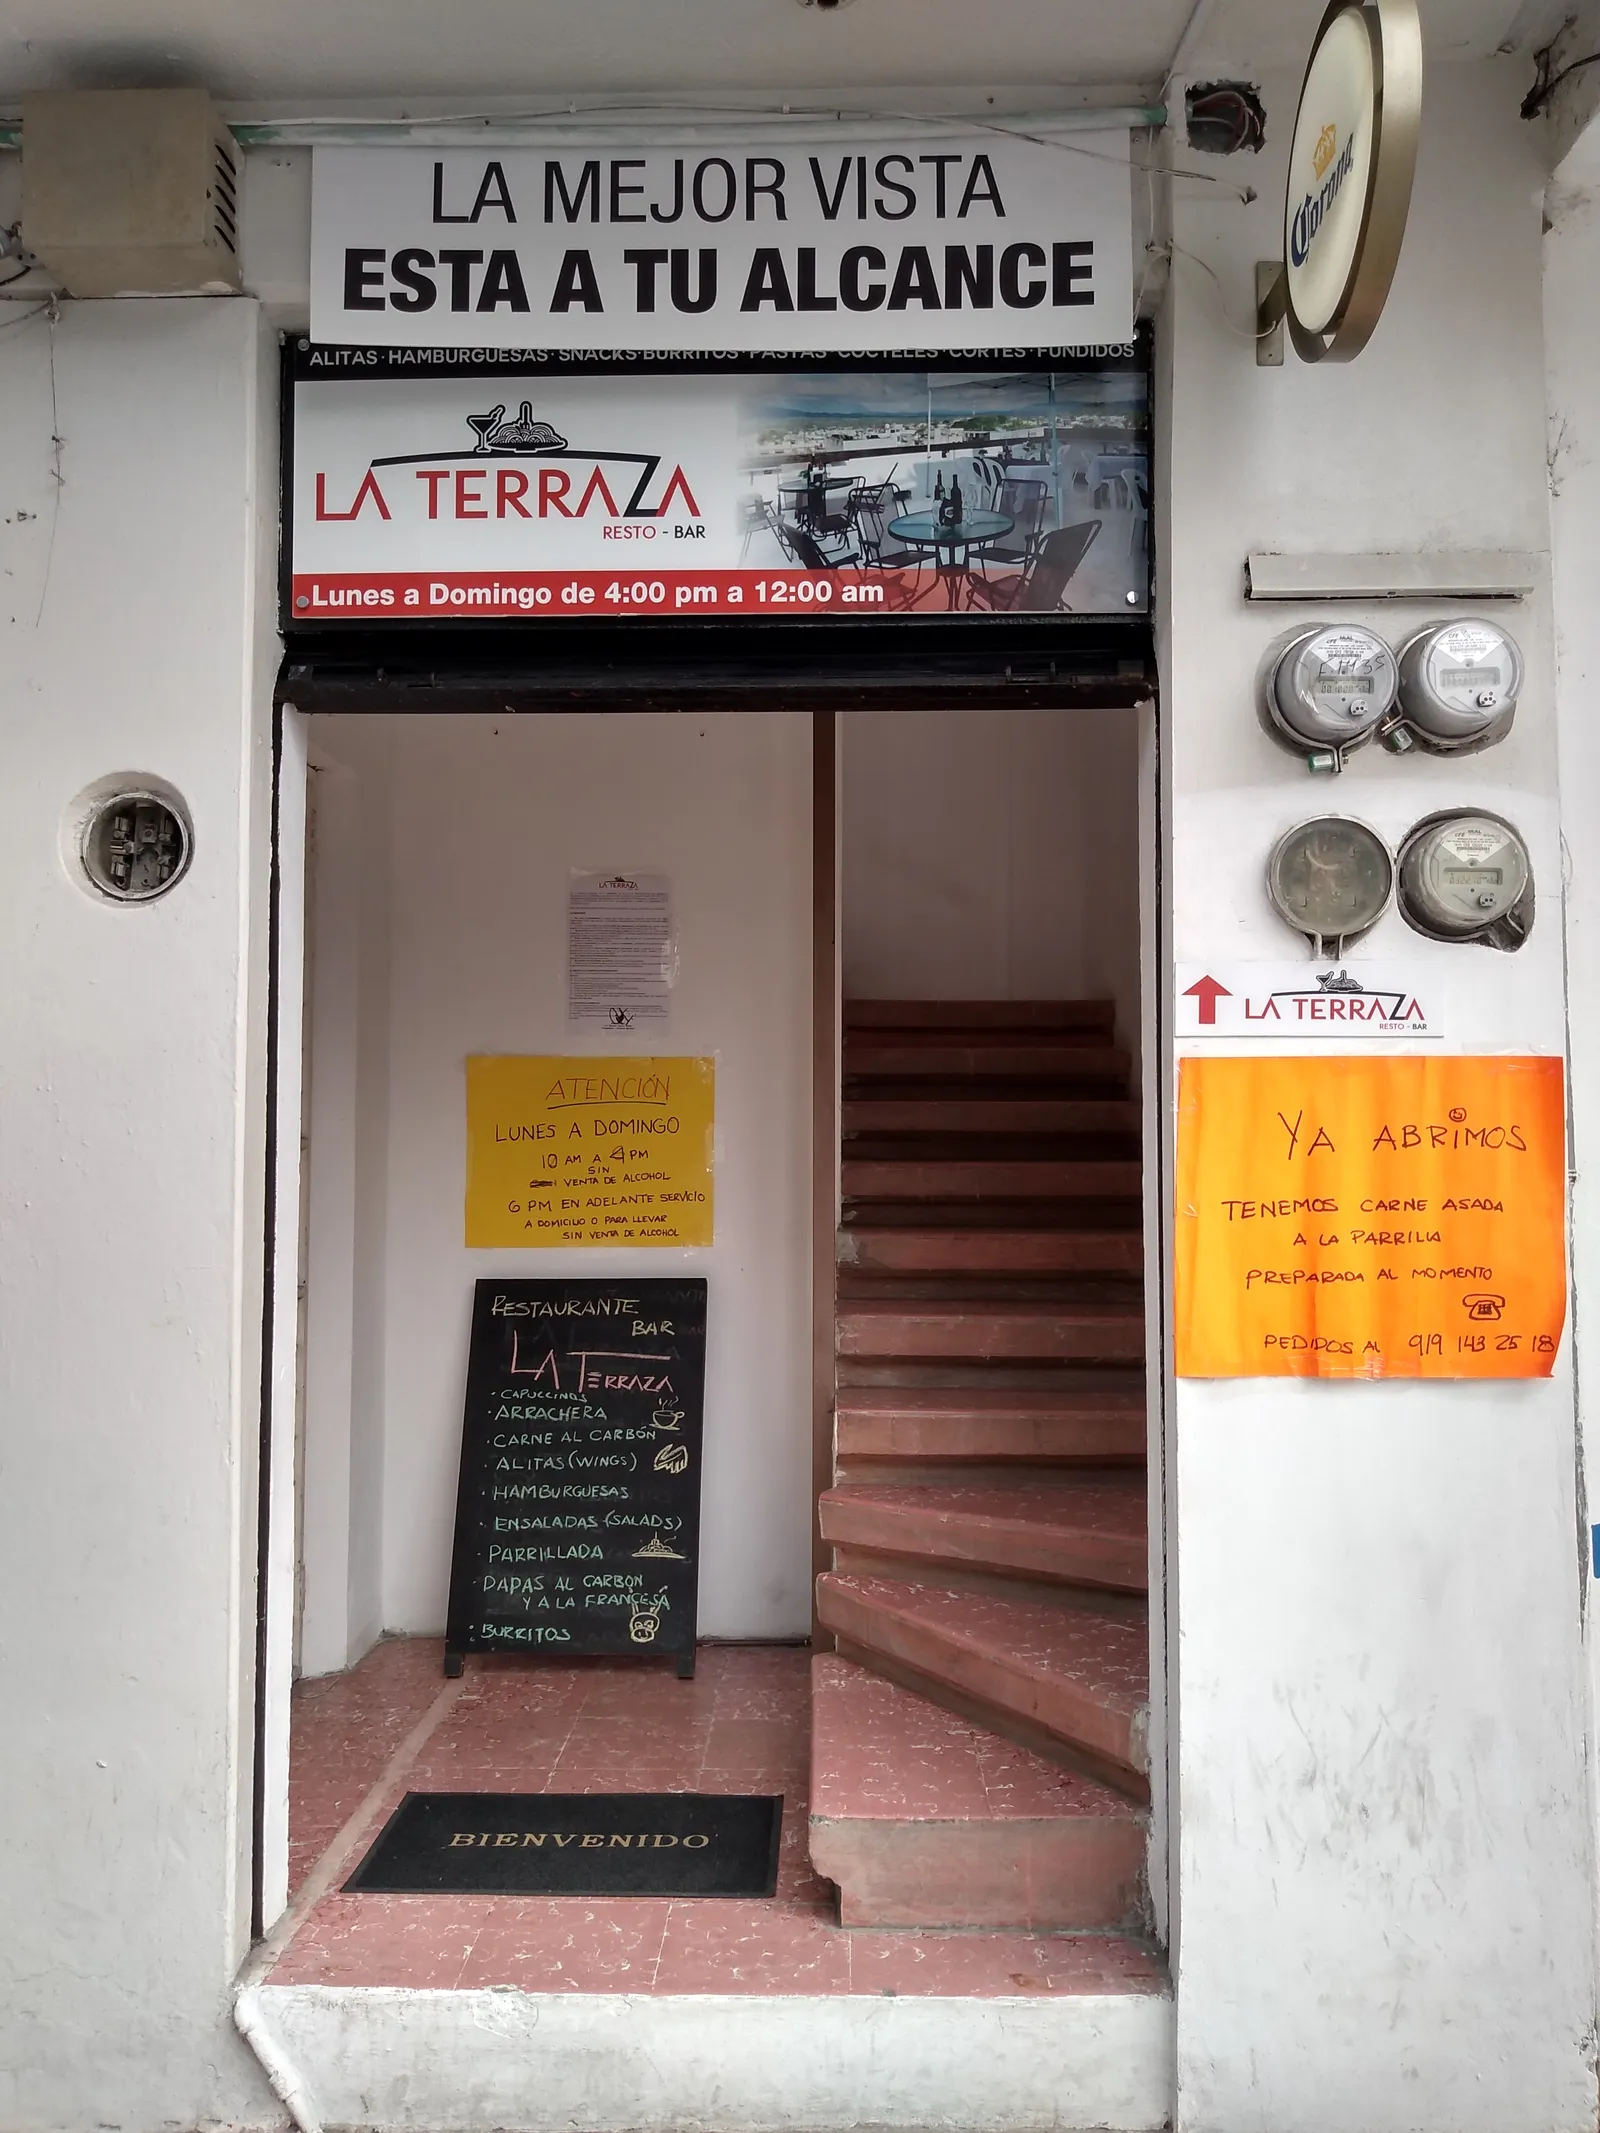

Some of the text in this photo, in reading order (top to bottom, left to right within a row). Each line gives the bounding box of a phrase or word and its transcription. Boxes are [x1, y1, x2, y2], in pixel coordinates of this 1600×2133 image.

[432, 154, 1007, 224] LA MEJOR VISTA
[1291, 132, 1354, 268] Corona
[343, 241, 1095, 314] ESTA A TU ALCANCE
[309, 350, 378, 366] ALITAS
[388, 348, 549, 365] HAMBURGUESAS
[558, 348, 637, 362] SNACKS
[643, 349, 739, 360] BURRITOS
[949, 347, 1027, 359] CORTES
[1037, 343, 1135, 359] FUNDIDOS
[315, 457, 702, 522] LA TERRAZA
[602, 525, 657, 540] RESTO
[674, 524, 707, 540] BAR
[312, 580, 885, 610] Lunes a Domingo de 4:00 pm a 12:00 am
[1245, 994, 1426, 1021] LA TERRAZA
[1379, 1022, 1405, 1030] RESTO
[545, 1074, 671, 1101] ATENCIÓN
[495, 1116, 681, 1143] LUNES A DOMINGO
[1277, 1109, 1336, 1161] YA
[541, 1145, 649, 1170] 10 AM A 4 PM
[563, 1177, 600, 1188] VENTA
[604, 1175, 617, 1185] DE
[623, 1171, 672, 1182] ALCOHOL
[588, 1165, 611, 1175] SIN
[508, 1190, 706, 1214] 6 PM EN ADELANTE SERVICIO
[1221, 1198, 1505, 1222] TENEMOS CARNE ASADA
[524, 1214, 667, 1229] A DOMICILIO O PARA LLEVAR
[562, 1227, 679, 1240] SIN VENTA DE ALCOHOL
[1293, 1229, 1442, 1247] A LA PARRILLA
[1246, 1265, 1493, 1290] PREPARADA AL MOMENTO
[491, 1296, 641, 1318] RESTAURANTE
[631, 1319, 676, 1337] BAR
[1263, 1334, 1354, 1355] PEDIDOS
[1408, 1333, 1443, 1356] 919
[1458, 1335, 1486, 1353] 143
[1494, 1334, 1523, 1351] 25
[1531, 1334, 1556, 1353] 18
[511, 1329, 675, 1393] LA TERRAZA
[494, 1404, 608, 1422] ARRACHERA
[492, 1425, 656, 1448] CARNE AL CARBÓN
[492, 1484, 630, 1501] HAMBURGUESAS
[494, 1515, 599, 1532] ENSALADAS
[488, 1543, 604, 1564] PARRILLADA
[554, 1576, 575, 1591] AL
[522, 1596, 532, 1610] Y
[537, 1595, 550, 1609] A
[555, 1597, 576, 1609] LA
[481, 1622, 572, 1643] BURRITOS
[447, 1832, 710, 1848] BIENVENIDO
